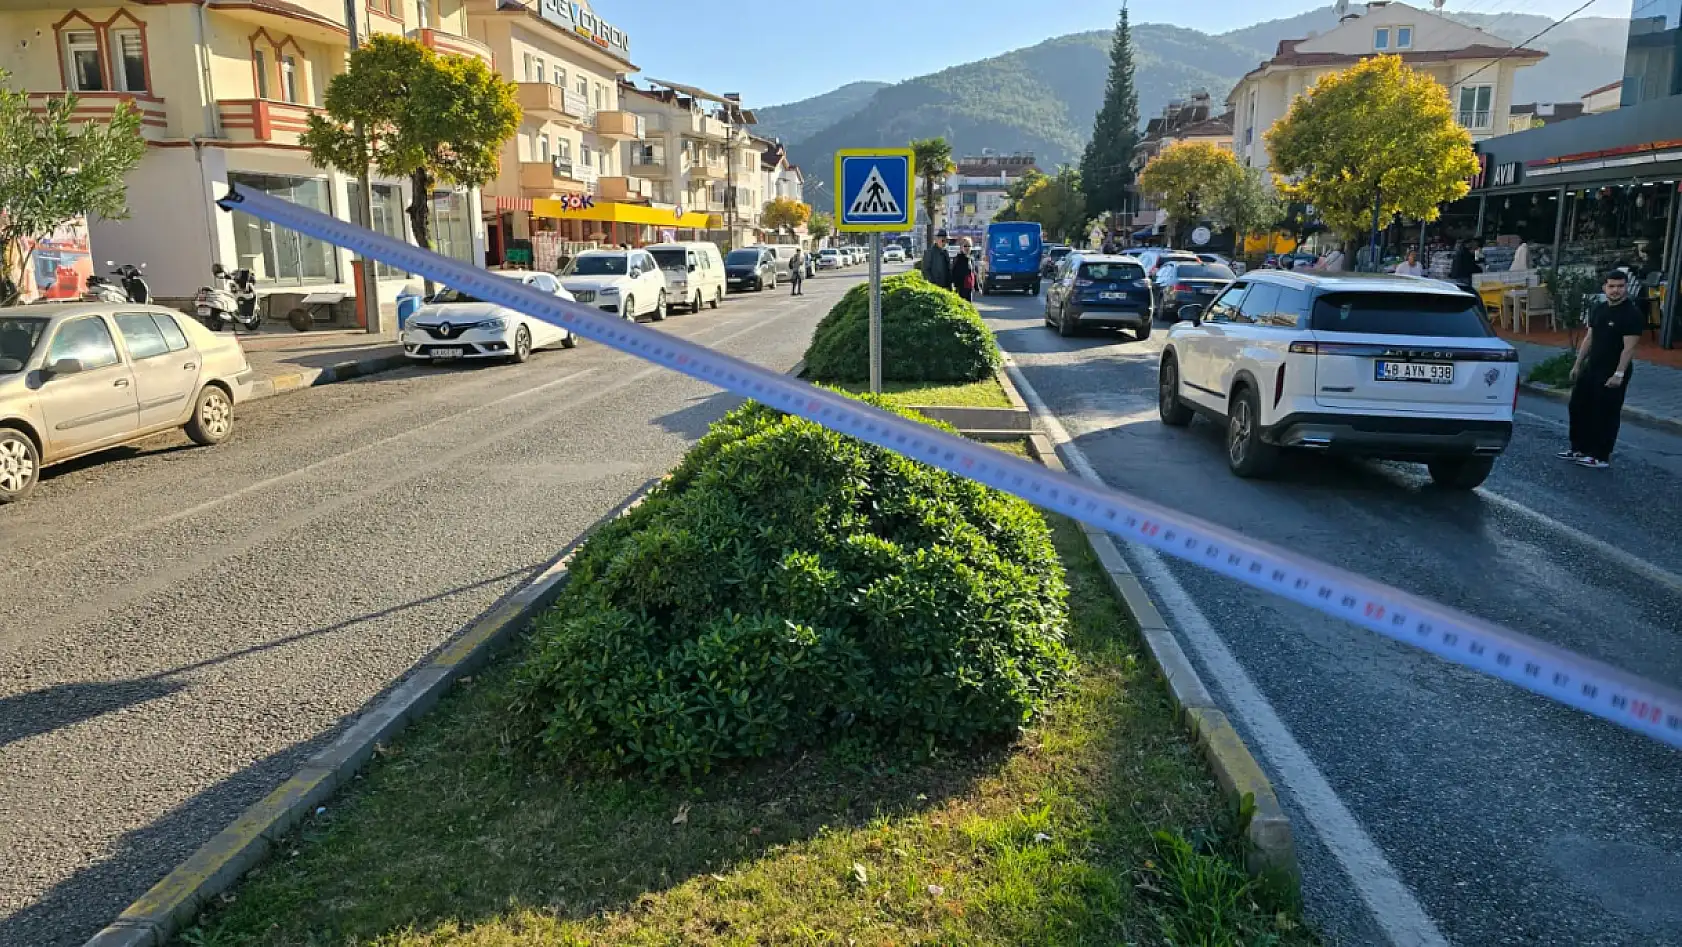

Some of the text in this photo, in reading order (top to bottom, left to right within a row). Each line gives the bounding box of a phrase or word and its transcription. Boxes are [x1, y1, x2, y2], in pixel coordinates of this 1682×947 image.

[1384, 362, 1451, 378] 48 AYN 938
